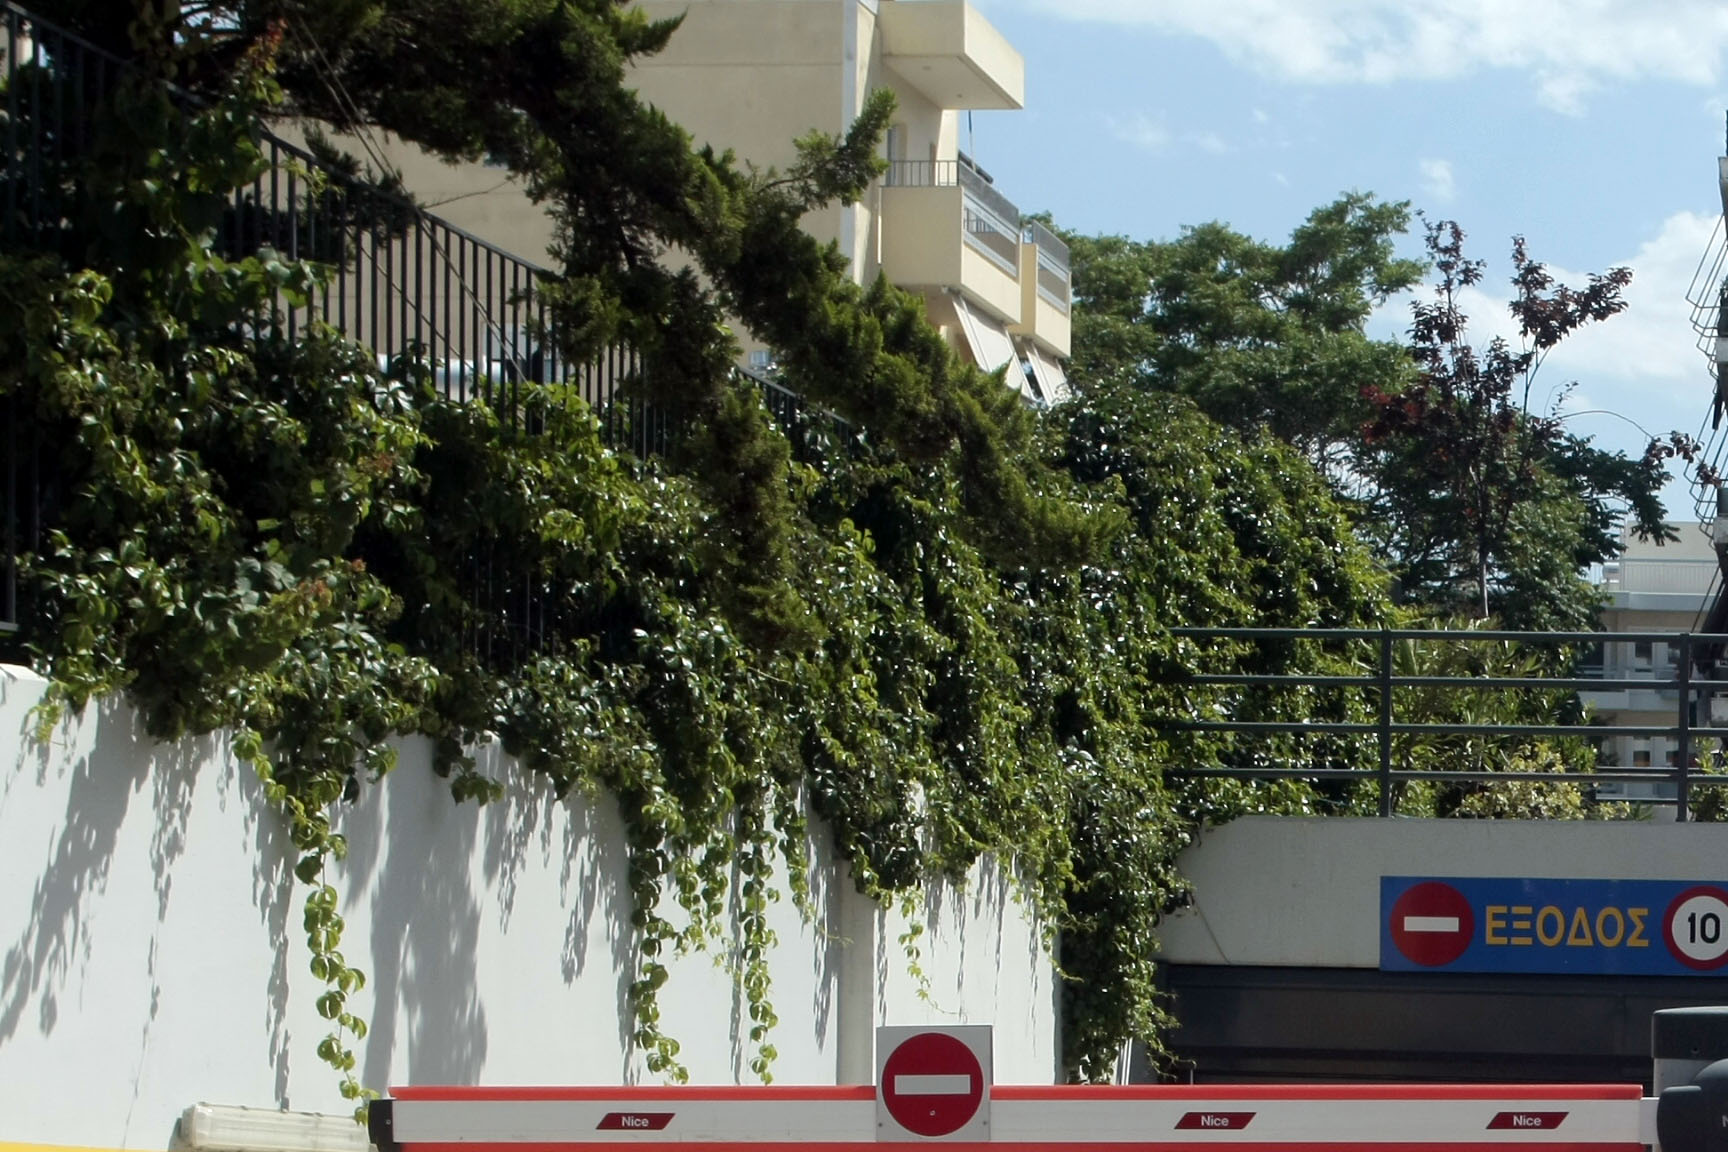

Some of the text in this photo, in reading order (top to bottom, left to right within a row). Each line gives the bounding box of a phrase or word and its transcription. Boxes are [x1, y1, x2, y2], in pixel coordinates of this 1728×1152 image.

[1485, 905, 1649, 947] ΕΞΟΔΟΣ
[1688, 912, 1721, 944] 10
[621, 1115, 649, 1127] Nice
[1201, 1115, 1229, 1127] Nice
[1513, 1114, 1541, 1126] Nice
